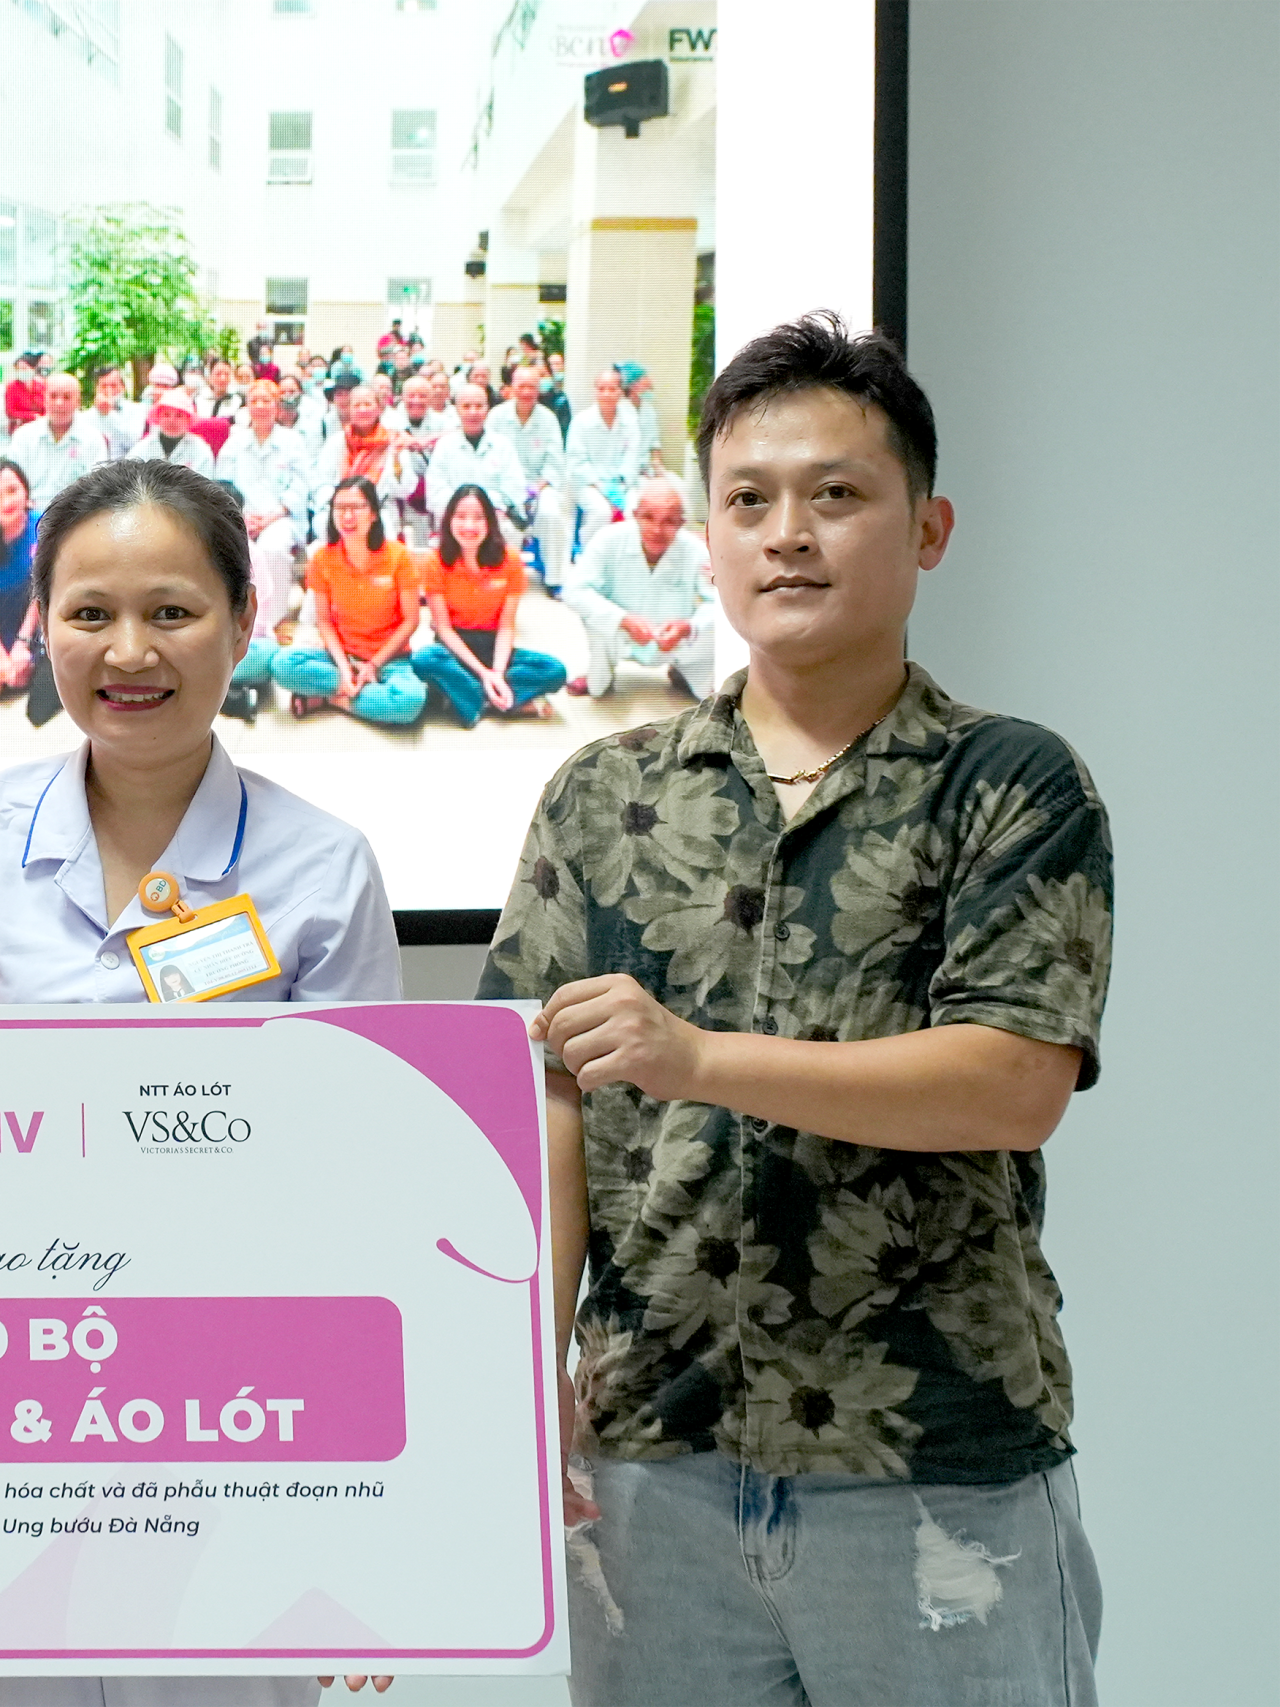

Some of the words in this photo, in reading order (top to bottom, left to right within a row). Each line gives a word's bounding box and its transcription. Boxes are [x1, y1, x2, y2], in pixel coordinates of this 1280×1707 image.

[140, 1085, 169, 1096] NTT
[173, 1082, 197, 1096] ÁO
[202, 1081, 231, 1096] LÓT
[38, 1237, 131, 1292] tặng
[29, 1306, 118, 1374] BỘ
[11, 1399, 53, 1443] &
[71, 1387, 164, 1443] ÁO
[185, 1386, 304, 1442] LÓT
[5, 1483, 44, 1498] hóa
[50, 1481, 95, 1498] chất
[102, 1482, 125, 1498] và
[132, 1482, 157, 1498] đã
[164, 1479, 217, 1501] phẫu
[224, 1482, 280, 1501] thuật
[286, 1482, 338, 1501] đoạn
[345, 1481, 384, 1498] nhũ
[3, 1519, 44, 1537] Ung
[51, 1517, 102, 1533] bướu
[109, 1516, 137, 1533] Đà
[145, 1514, 199, 1537] Nẵng
